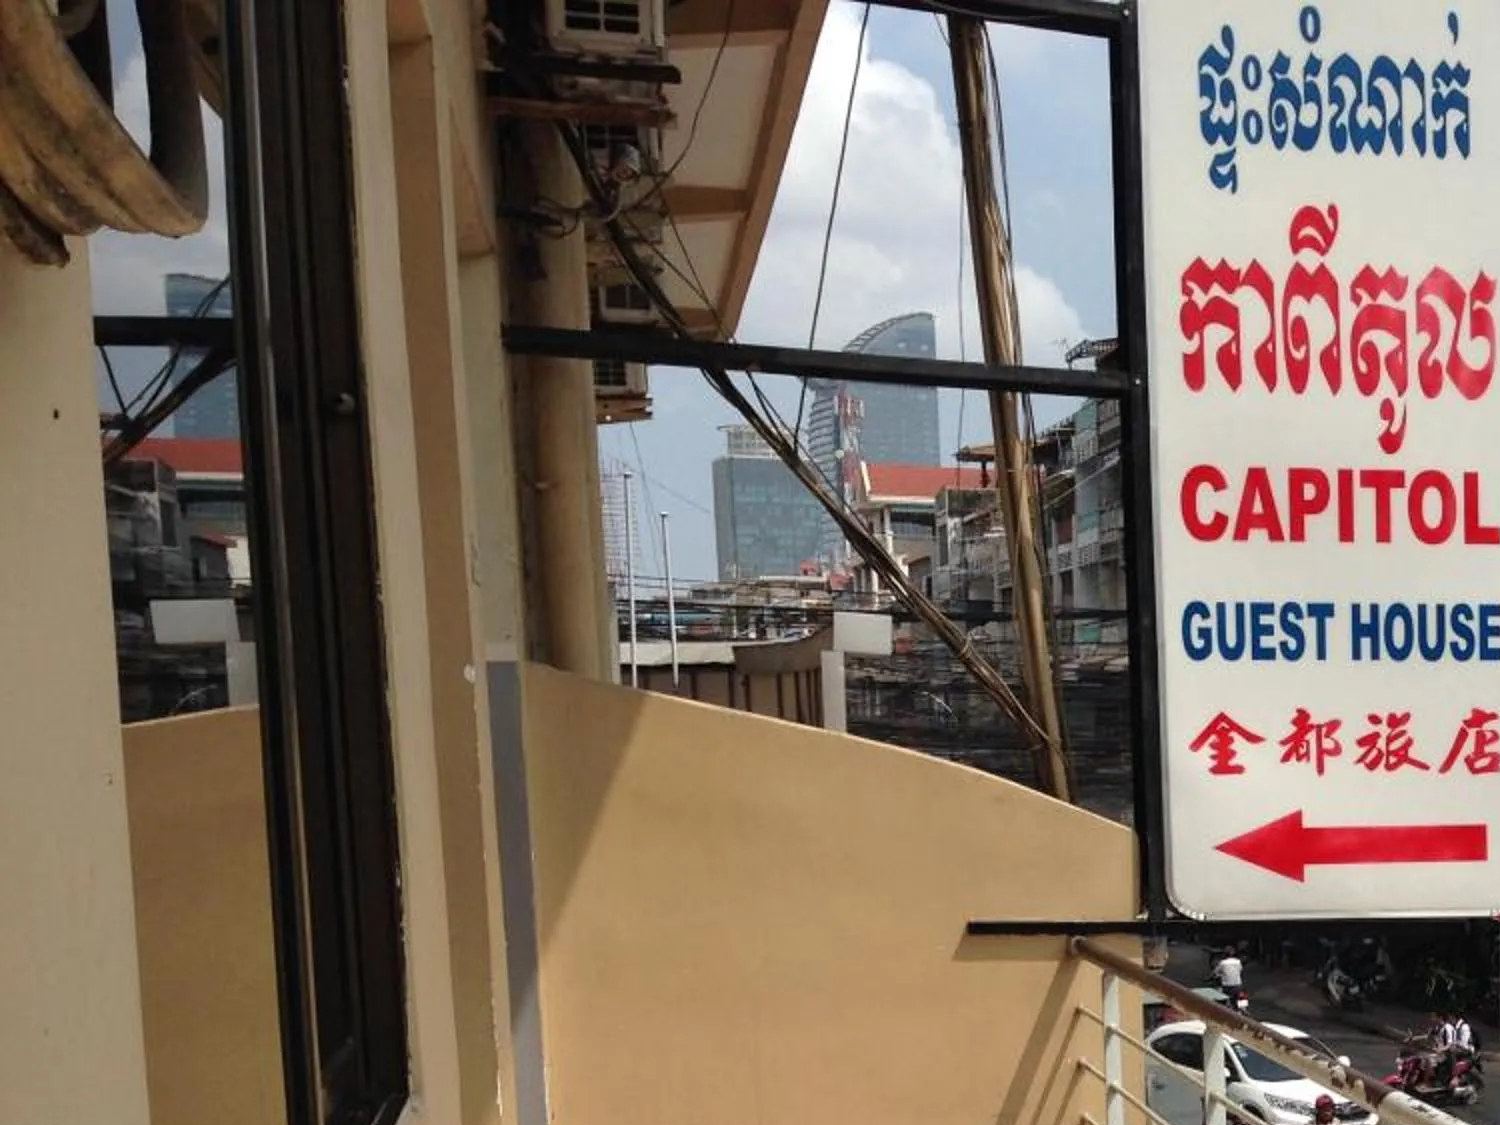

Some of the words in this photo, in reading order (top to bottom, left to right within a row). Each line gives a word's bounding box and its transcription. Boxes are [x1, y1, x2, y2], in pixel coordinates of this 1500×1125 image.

[1198, 6, 1471, 194] ផ្ទះសំណាក់
[1181, 600, 1335, 661] GUEST
